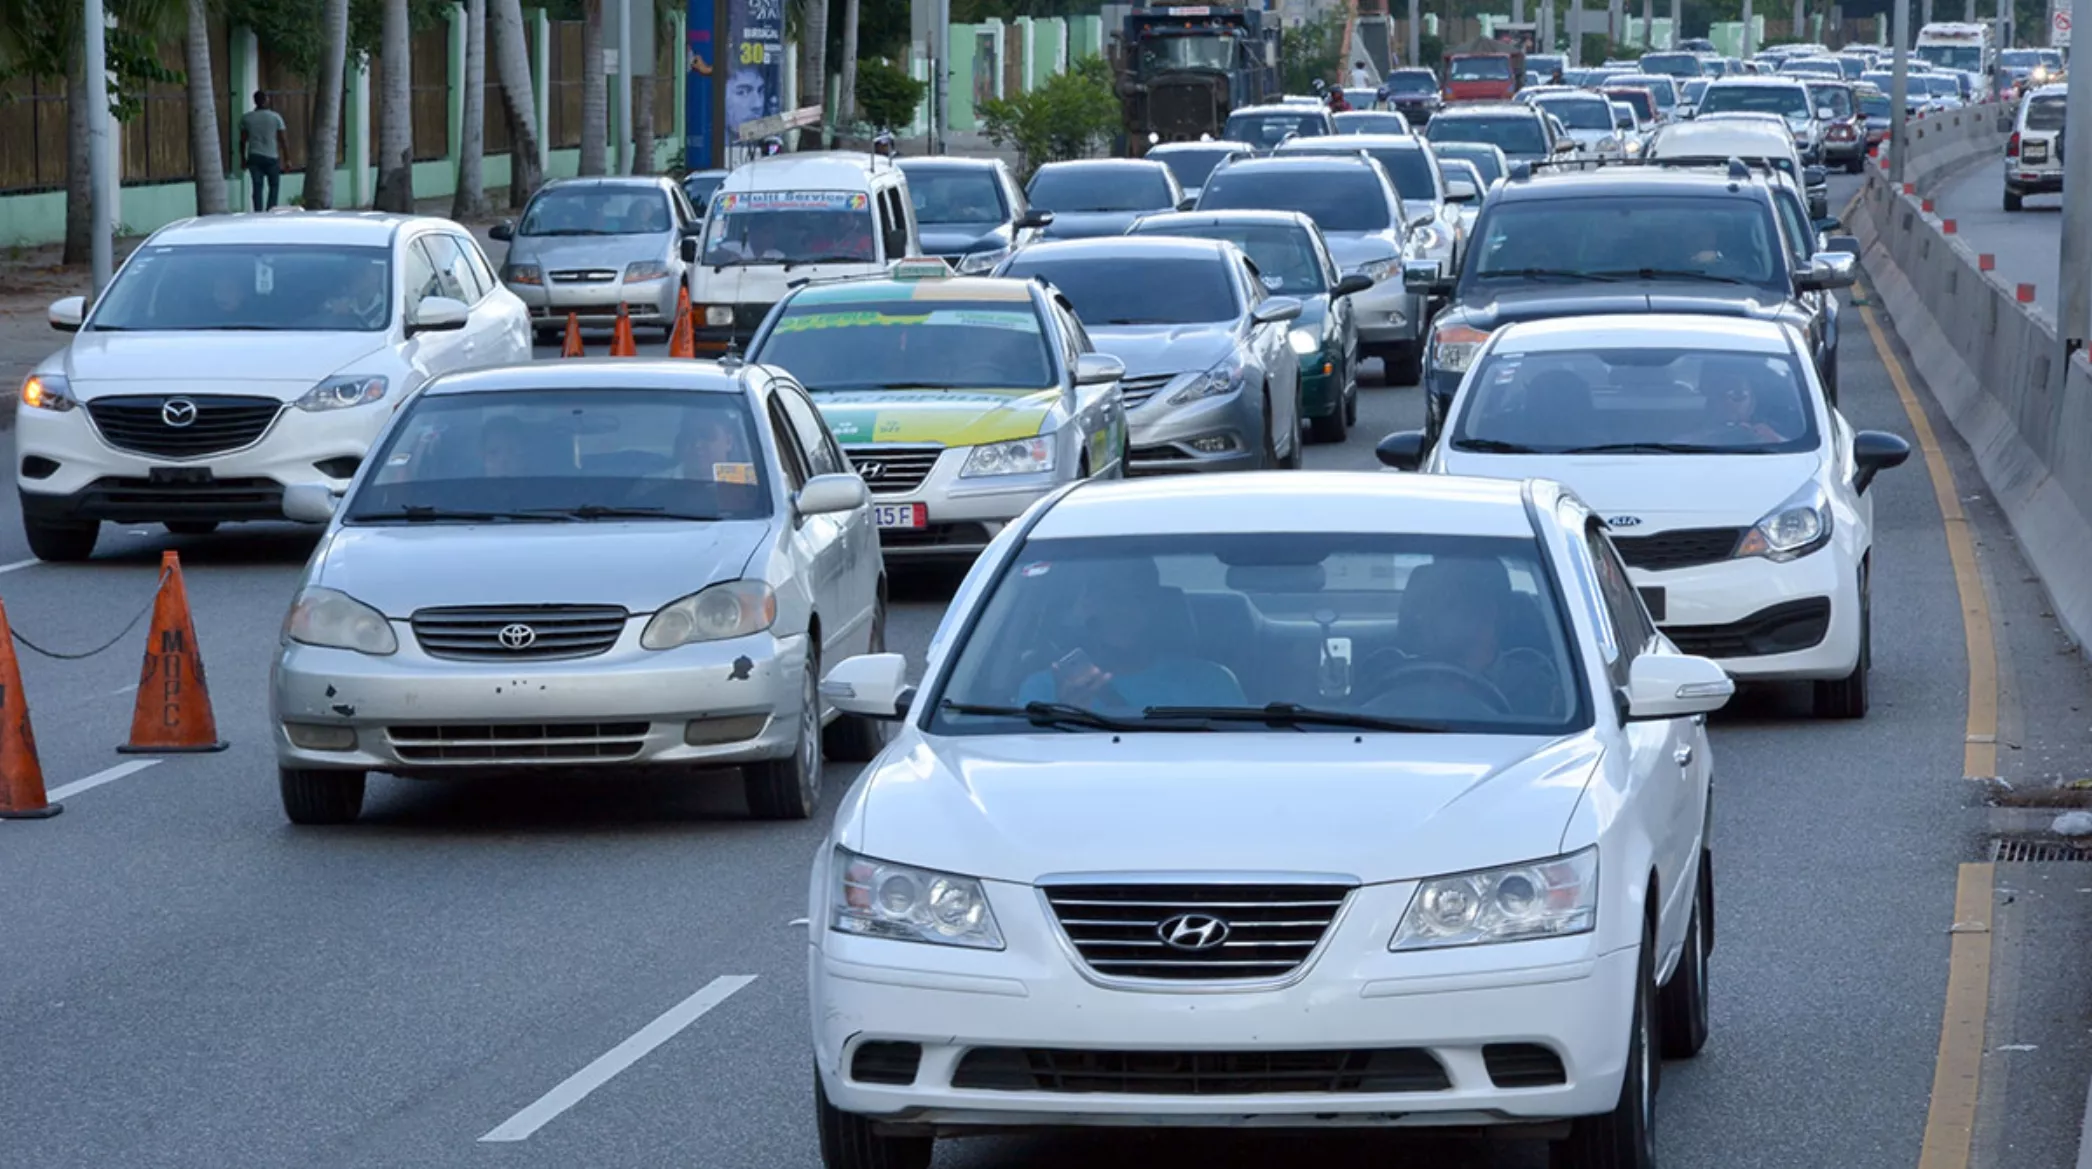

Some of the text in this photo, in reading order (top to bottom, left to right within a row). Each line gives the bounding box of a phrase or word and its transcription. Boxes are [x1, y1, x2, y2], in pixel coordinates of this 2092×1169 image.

[740, 41, 763, 64] 30
[899, 507, 911, 525] F
[1613, 517, 1636, 526] KIA
